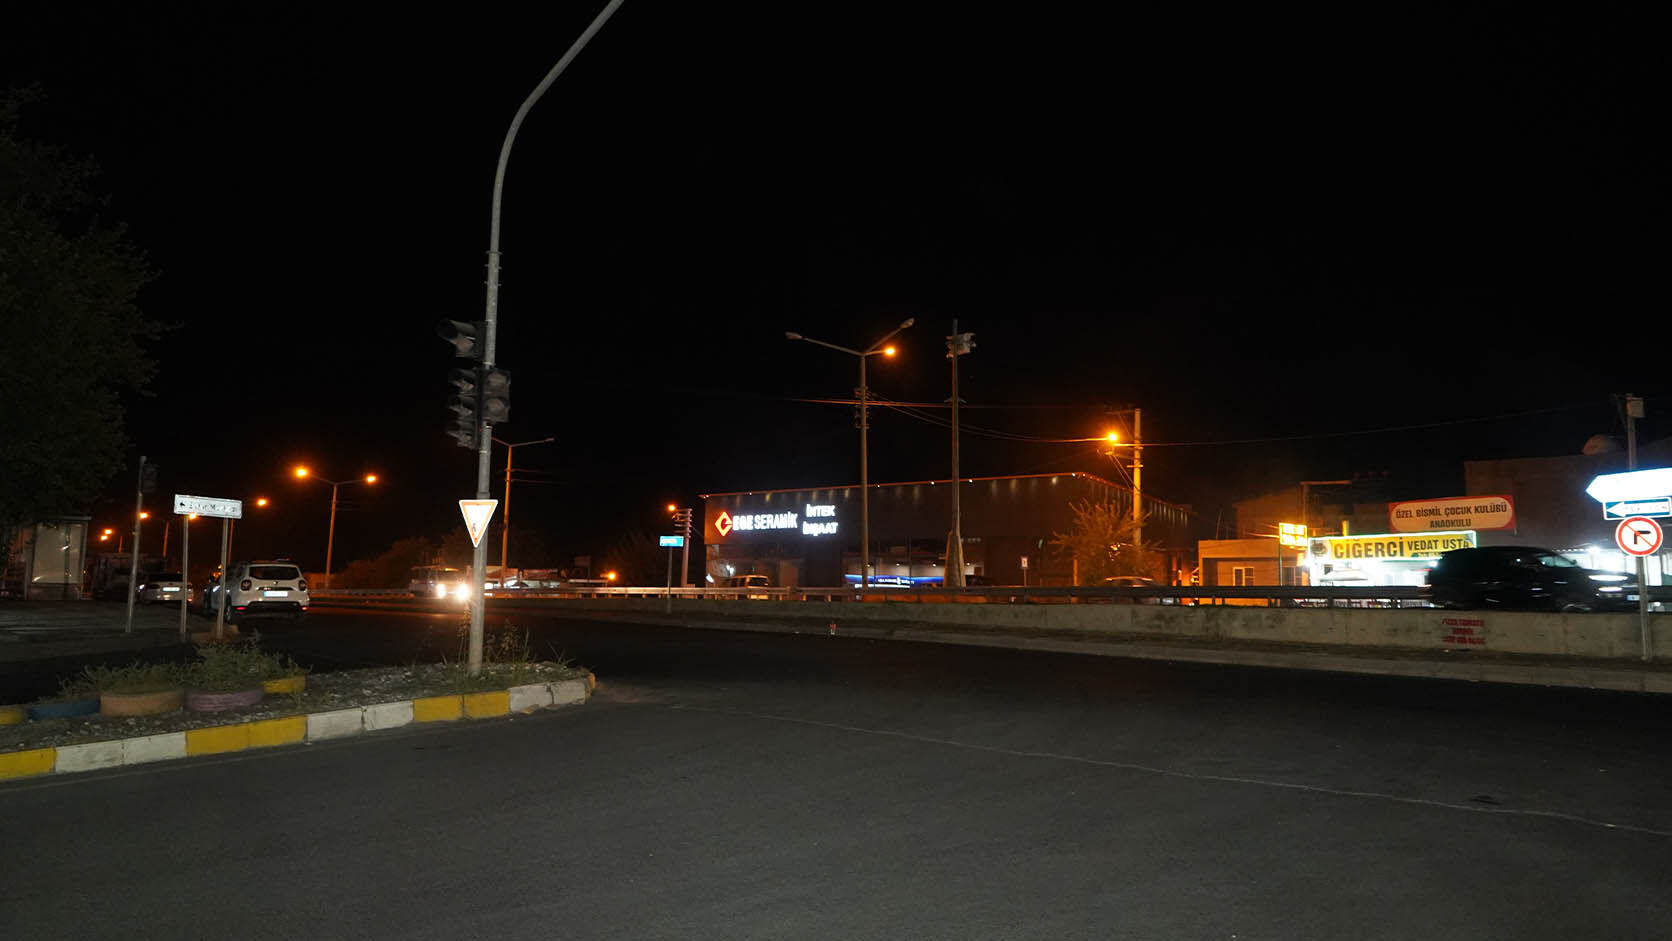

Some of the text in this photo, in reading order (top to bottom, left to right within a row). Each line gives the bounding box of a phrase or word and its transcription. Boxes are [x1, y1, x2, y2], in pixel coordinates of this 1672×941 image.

[1395, 502, 1507, 519] ÖZEL BİSMİL ÇOCUK KULÜBÜ
[754, 511, 798, 529] SERAMİK
[1430, 518, 1472, 529] ANAOKULU
[1407, 540, 1439, 551] VEDAT
[1442, 538, 1469, 550] USTA
